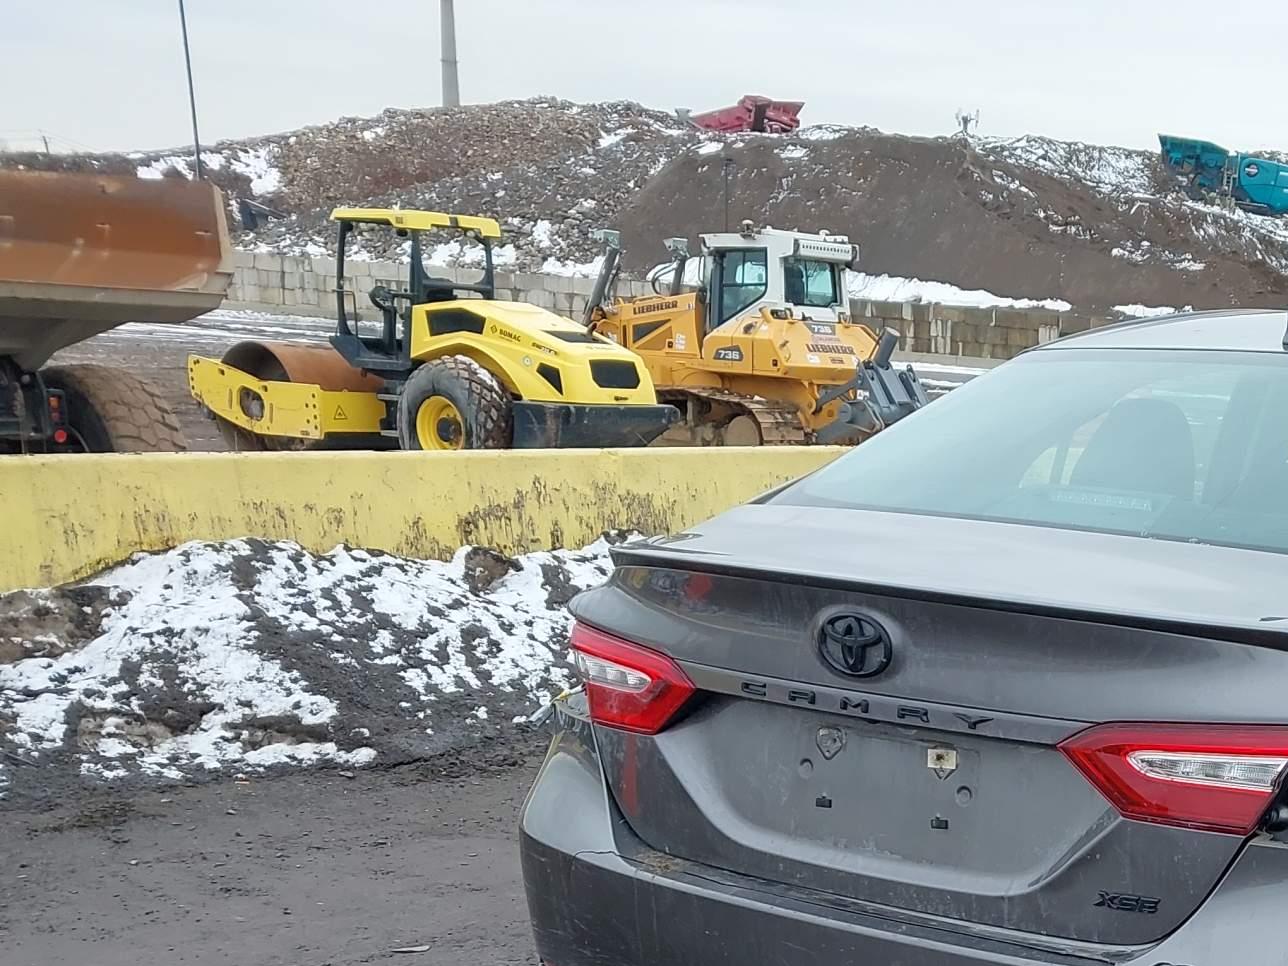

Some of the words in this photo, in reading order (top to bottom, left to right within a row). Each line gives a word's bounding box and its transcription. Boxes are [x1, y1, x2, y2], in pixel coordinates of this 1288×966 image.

[633, 300, 678, 315] LIEBHERR
[806, 343, 856, 355] LIEBHERR
[741, 681, 994, 730] CAMRY
[1093, 890, 1161, 914] XSE
